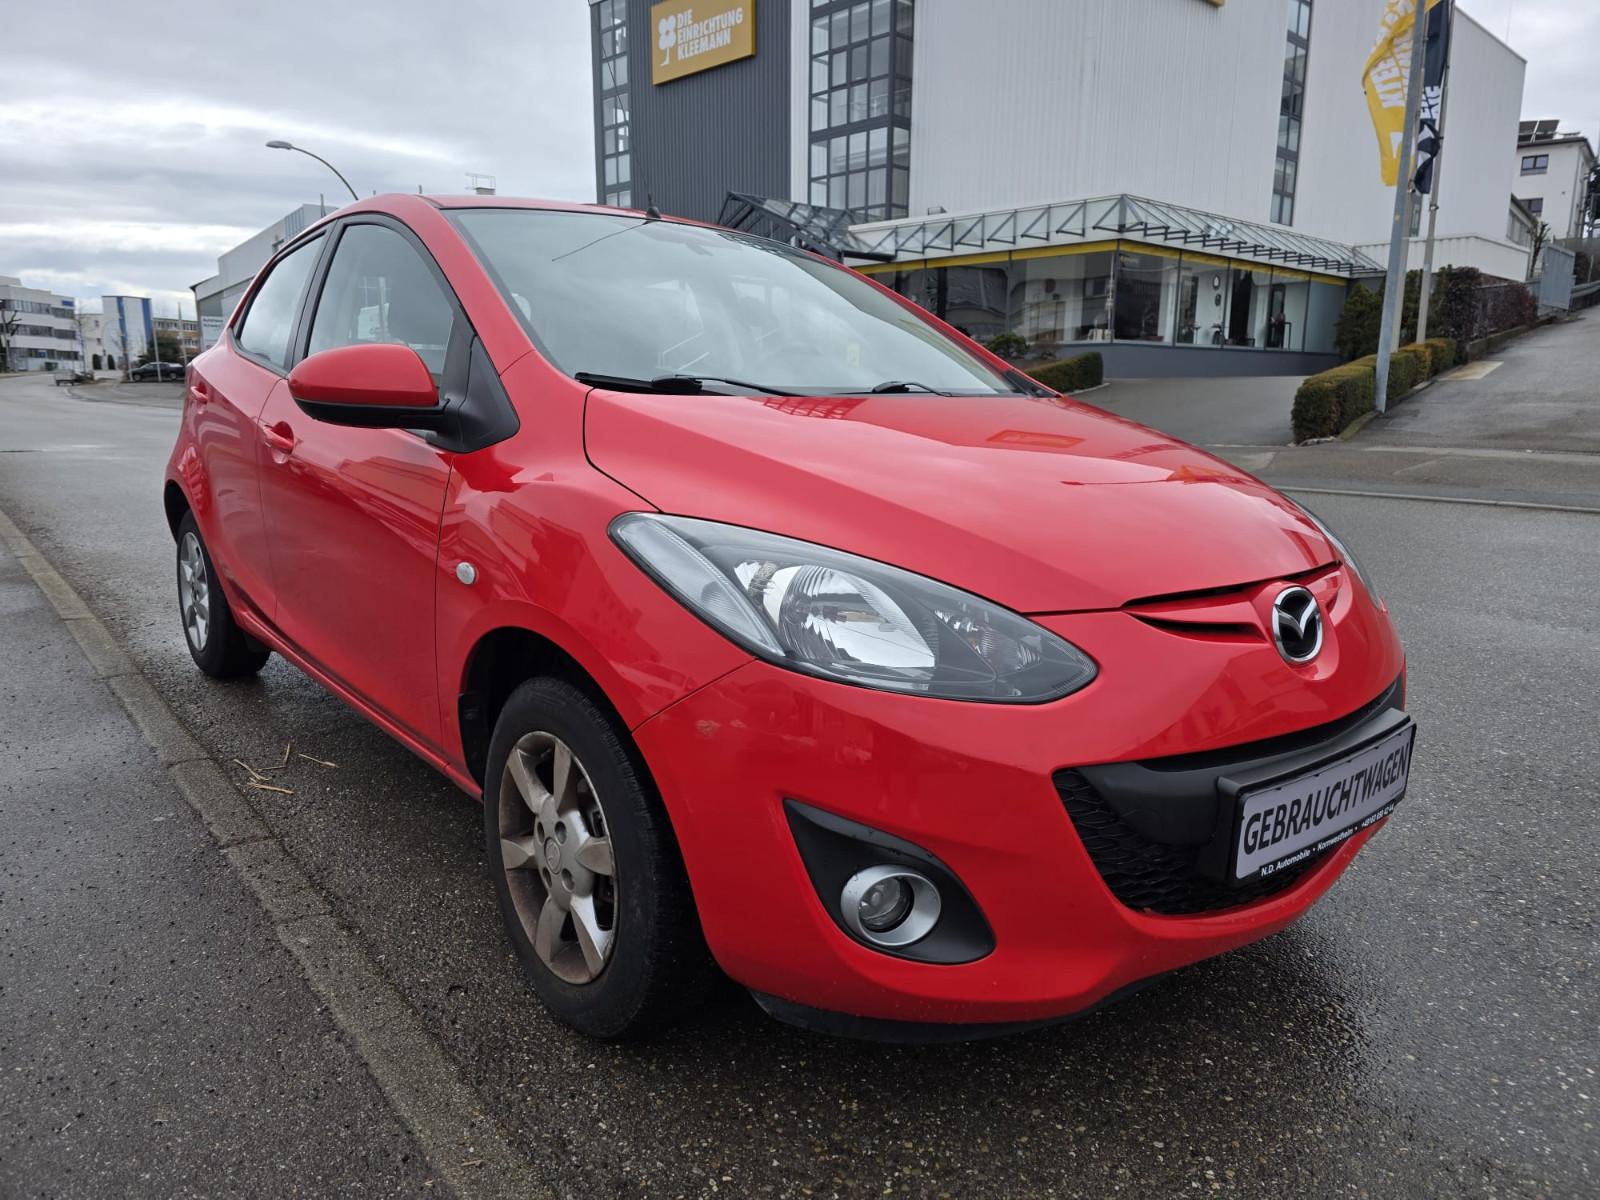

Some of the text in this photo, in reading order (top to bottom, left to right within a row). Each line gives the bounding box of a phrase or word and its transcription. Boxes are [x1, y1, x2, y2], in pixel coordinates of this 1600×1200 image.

[677, 8, 693, 29] DIE
[677, 7, 743, 45] EINRICHTUNG
[677, 28, 731, 60] KLEEMANN
[1243, 742, 1410, 856] GEBRAUCHTWAGEN
[1261, 864, 1275, 877] N.D.
[1276, 849, 1310, 870] Automobile
